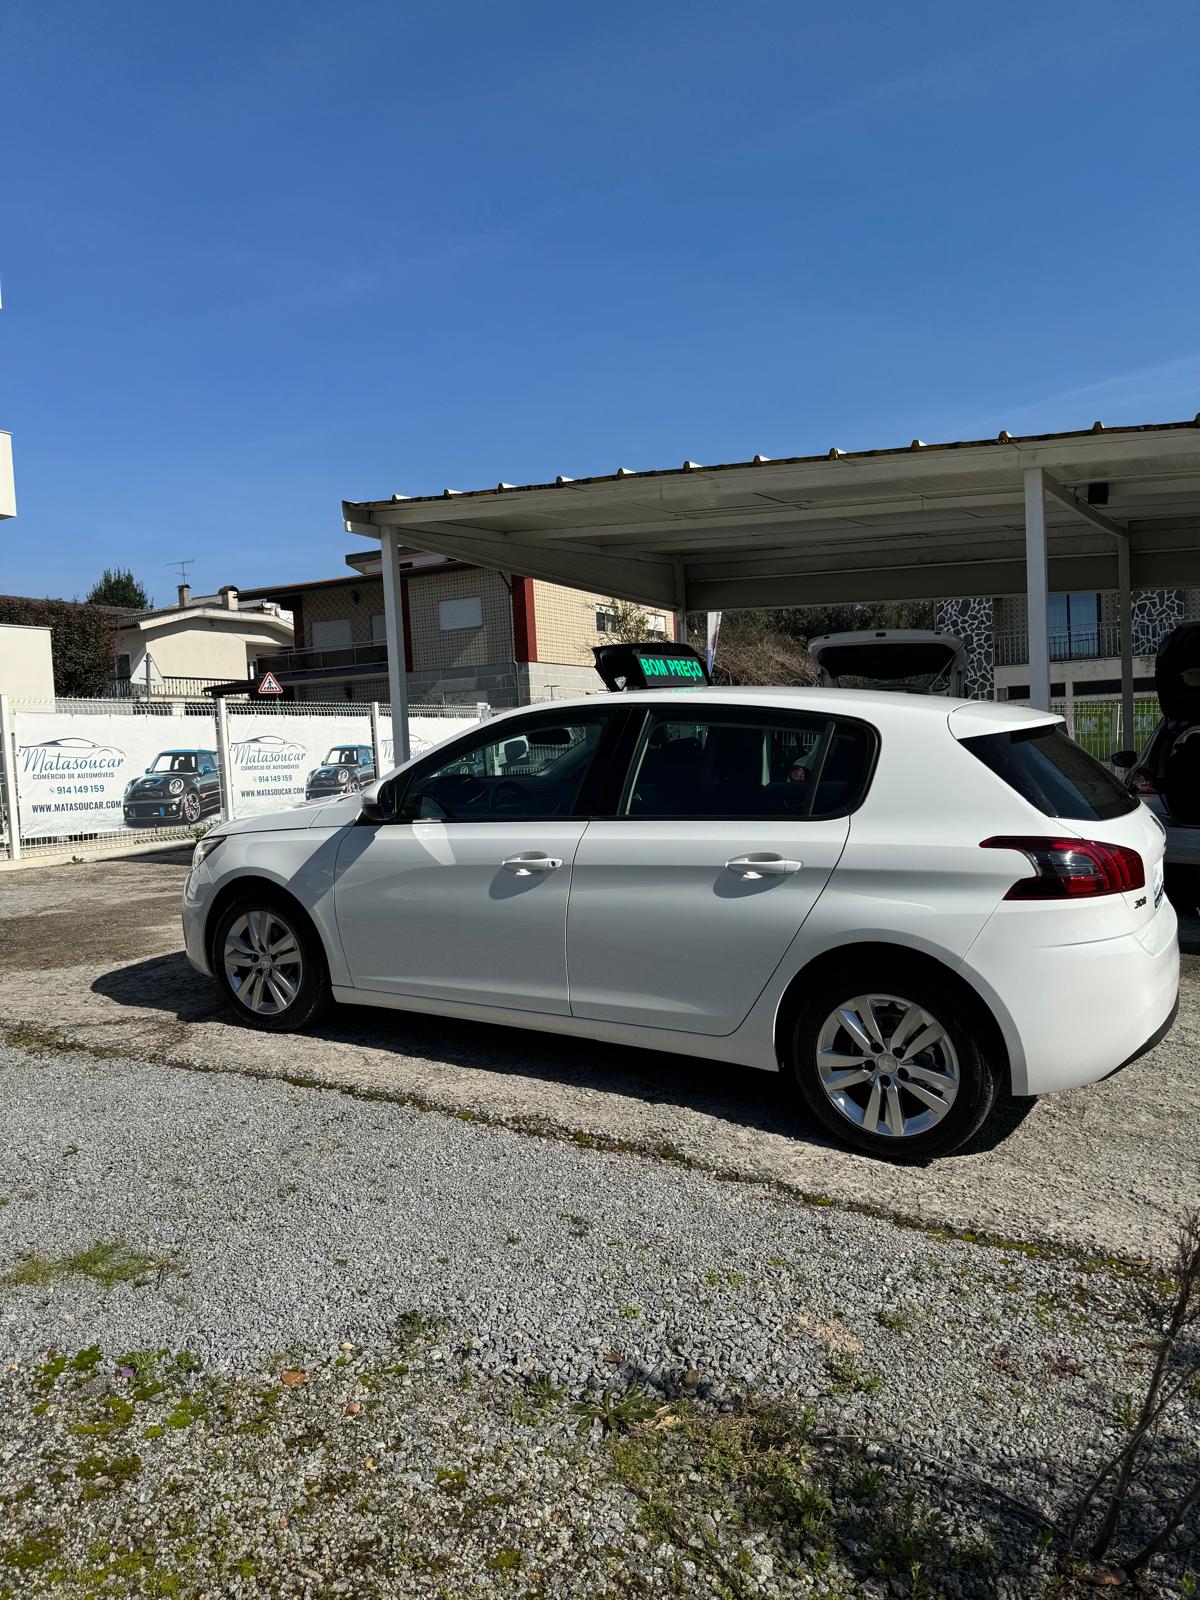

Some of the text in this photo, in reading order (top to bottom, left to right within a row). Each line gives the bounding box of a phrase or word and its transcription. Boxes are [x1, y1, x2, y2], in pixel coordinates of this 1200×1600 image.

[640, 658, 703, 681] BOM PREÇO
[22, 748, 124, 773] Matasoucar
[234, 744, 306, 765] Matasoucar
[32, 772, 66, 780] COMÉRCIO
[77, 771, 115, 779] AUTOMÓVEIS
[241, 787, 305, 798] WWW.MATASOUCAR.COM
[32, 800, 122, 813] WWW.MATASOUCAR.COM
